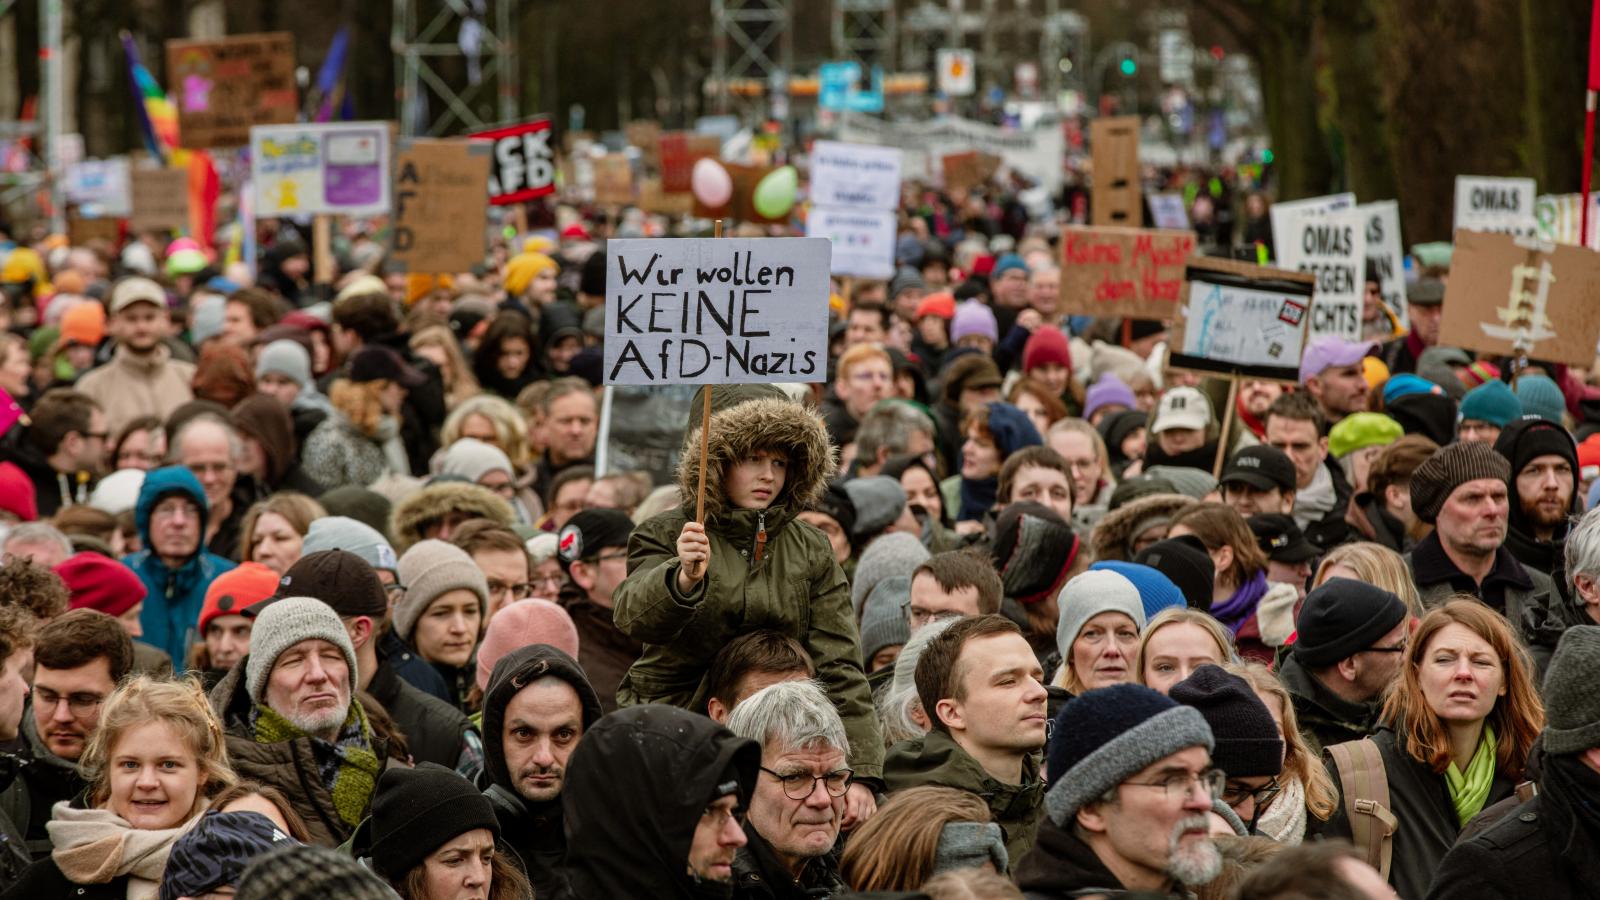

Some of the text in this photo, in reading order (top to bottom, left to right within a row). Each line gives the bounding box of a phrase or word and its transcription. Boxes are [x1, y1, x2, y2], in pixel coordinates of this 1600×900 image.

[496, 130, 552, 165] CK
[1471, 187, 1521, 211] OMAS
[1303, 225, 1354, 256] OMAS
[617, 251, 794, 286] Wir wollen
[617, 290, 772, 337] KEINE
[1312, 303, 1358, 333] CHTS
[609, 338, 817, 381] AfD-Nazis
